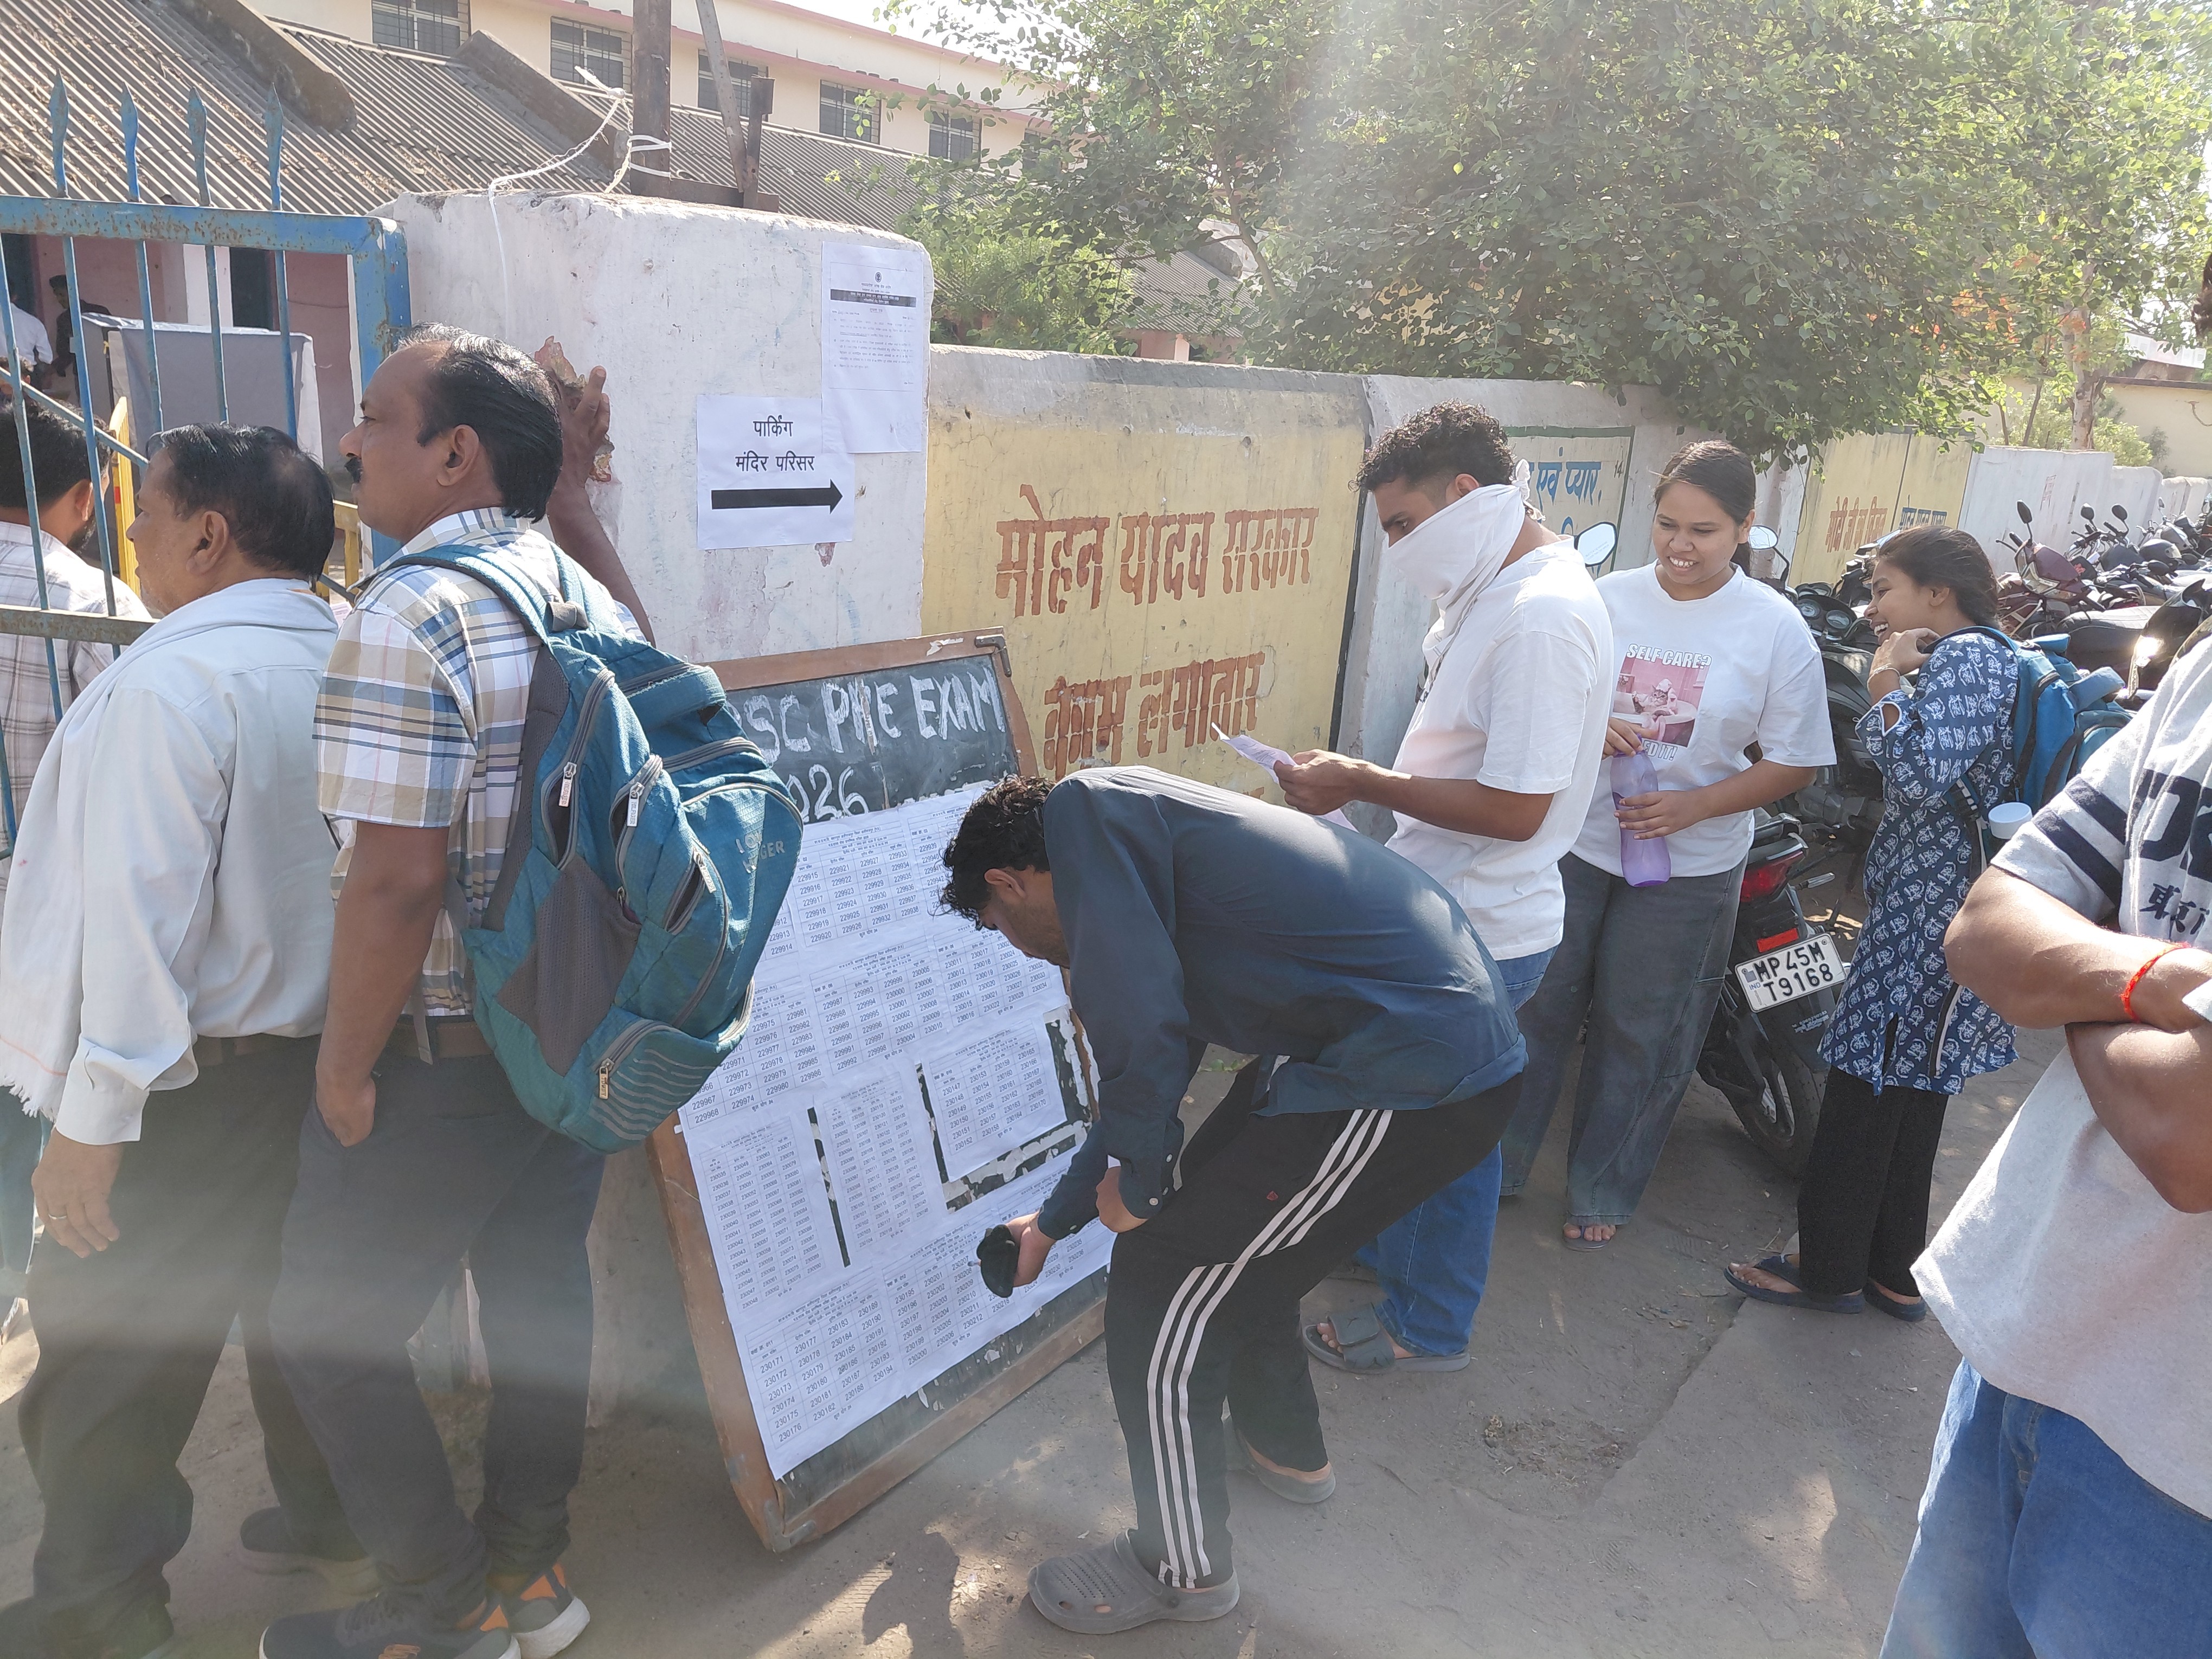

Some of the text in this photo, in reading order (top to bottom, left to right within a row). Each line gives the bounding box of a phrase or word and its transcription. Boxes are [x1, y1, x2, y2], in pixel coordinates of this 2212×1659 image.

[753, 415, 793, 436] पार्किंग
[735, 451, 815, 472] मंदिर परिसर
[995, 484, 1320, 619] मोहन यादव सरकार
[1626, 643, 1713, 670] SELF CARE?
[909, 666, 1006, 742] EXAM
[1044, 652, 1266, 781] काम लगातार
[1643, 741, 1678, 761] ED IT!
[786, 763, 869, 823] 026
[919, 843, 937, 852] 229939
[922, 854, 939, 864] 229940
[798, 851, 906, 882] 229915 229921 229927 229933
[800, 861, 909, 894] 229916 229922 229928 229934
[927, 876, 944, 886] 229942
[803, 873, 911, 906] 229917 229923 229929 229935
[806, 884, 914, 918] 229918 229924 229930 229936
[808, 895, 916, 930] 229919 229925 229931 229937
[811, 906, 918, 942] 229920 229926 229932 229938
[769, 930, 790, 941] 229913
[771, 943, 792, 955] 229914
[945, 949, 988, 968] 230011 230017
[947, 959, 990, 979] 230012 230018
[823, 966, 930, 1010] 229987 229993 229999 230005
[950, 969, 993, 990] 230013 230019
[953, 980, 995, 1001] 230014 230020
[1748, 982, 1761, 991] IND
[1763, 963, 1833, 1001] T9168
[826, 978, 932, 1022] 229988 229994 230000 230006
[828, 988, 935, 1034] 229989 229995 230001 230007
[955, 991, 997, 1012] 230015 230021
[957, 1001, 999, 1023] 230016 230022
[753, 1008, 807, 1032] 229975 229981
[755, 1020, 809, 1045] 229976 229982
[832, 1000, 937, 1046] 229990 229996 230002 230008
[834, 1011, 940, 1058] 229991 229997 230003 230009
[723, 1033, 813, 1070] 229971 229977 229983
[837, 1022, 942, 1070] 229992 229998 230004 230010
[726, 1045, 815, 1083] 229972 229978 229984
[692, 1057, 818, 1110] 229967 229973 229979 229985
[695, 1069, 821, 1123] 229968 229974 229980 229986
[895, 1289, 915, 1304] 230195
[898, 1301, 917, 1316] 230196
[901, 1313, 919, 1328] 230197
[903, 1324, 922, 1341] 230198
[761, 1356, 783, 1373] 230171
[794, 1337, 816, 1354] 230177
[828, 1319, 848, 1335] 230183
[858, 1302, 878, 1317] 230189
[764, 1314, 881, 1387] 230172 230178 230184 230190
[906, 1336, 924, 1353] 230199
[768, 1327, 884, 1401] 230173 230179 230185 230191
[908, 1349, 927, 1365] 230200
[771, 1397, 794, 1414] 230174
[806, 1377, 828, 1394] 230180
[867, 1340, 887, 1356] 230192
[775, 1352, 890, 1429] 230175 230181 230187 230193
[779, 1365, 893, 1442] 230176 230182 230188 230194
